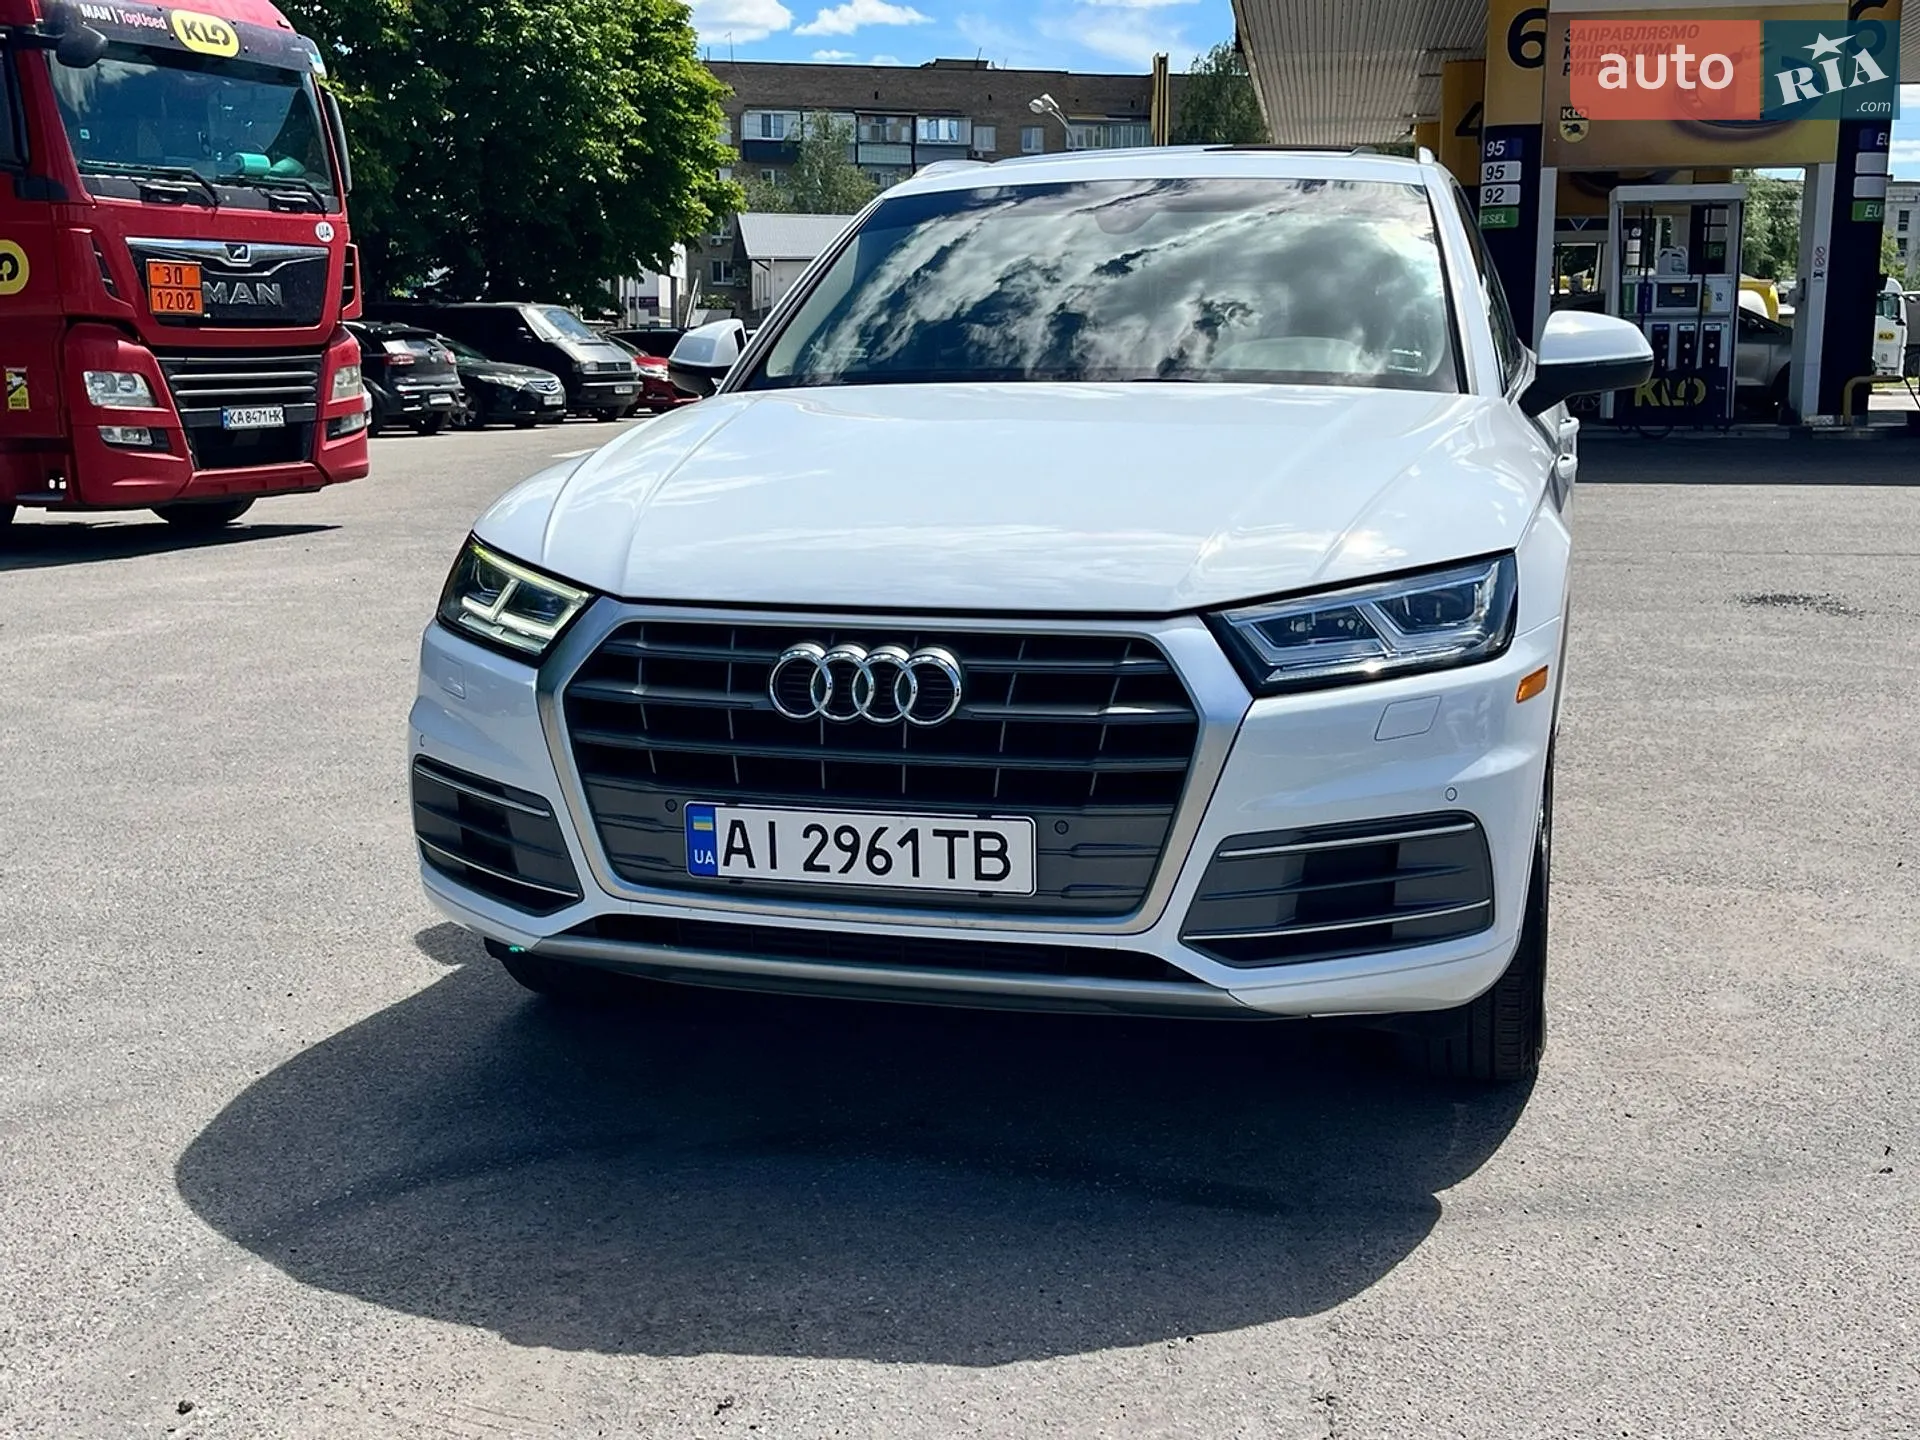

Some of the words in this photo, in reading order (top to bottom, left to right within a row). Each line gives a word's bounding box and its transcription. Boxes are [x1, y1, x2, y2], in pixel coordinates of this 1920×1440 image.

[80, 4, 112, 22] MAN
[117, 9, 167, 30] TopUsed
[1507, 8, 1546, 69] 6
[1564, 24, 1700, 42] ЗАПРАВЛЯЄМО
[1486, 140, 1506, 157] 95
[1486, 165, 1506, 181] 95
[1485, 188, 1505, 203] 92
[318, 226, 332, 239] UA
[163, 266, 183, 286] 30
[157, 290, 196, 310] 1202
[202, 281, 284, 306] MAN
[694, 849, 716, 866] UA
